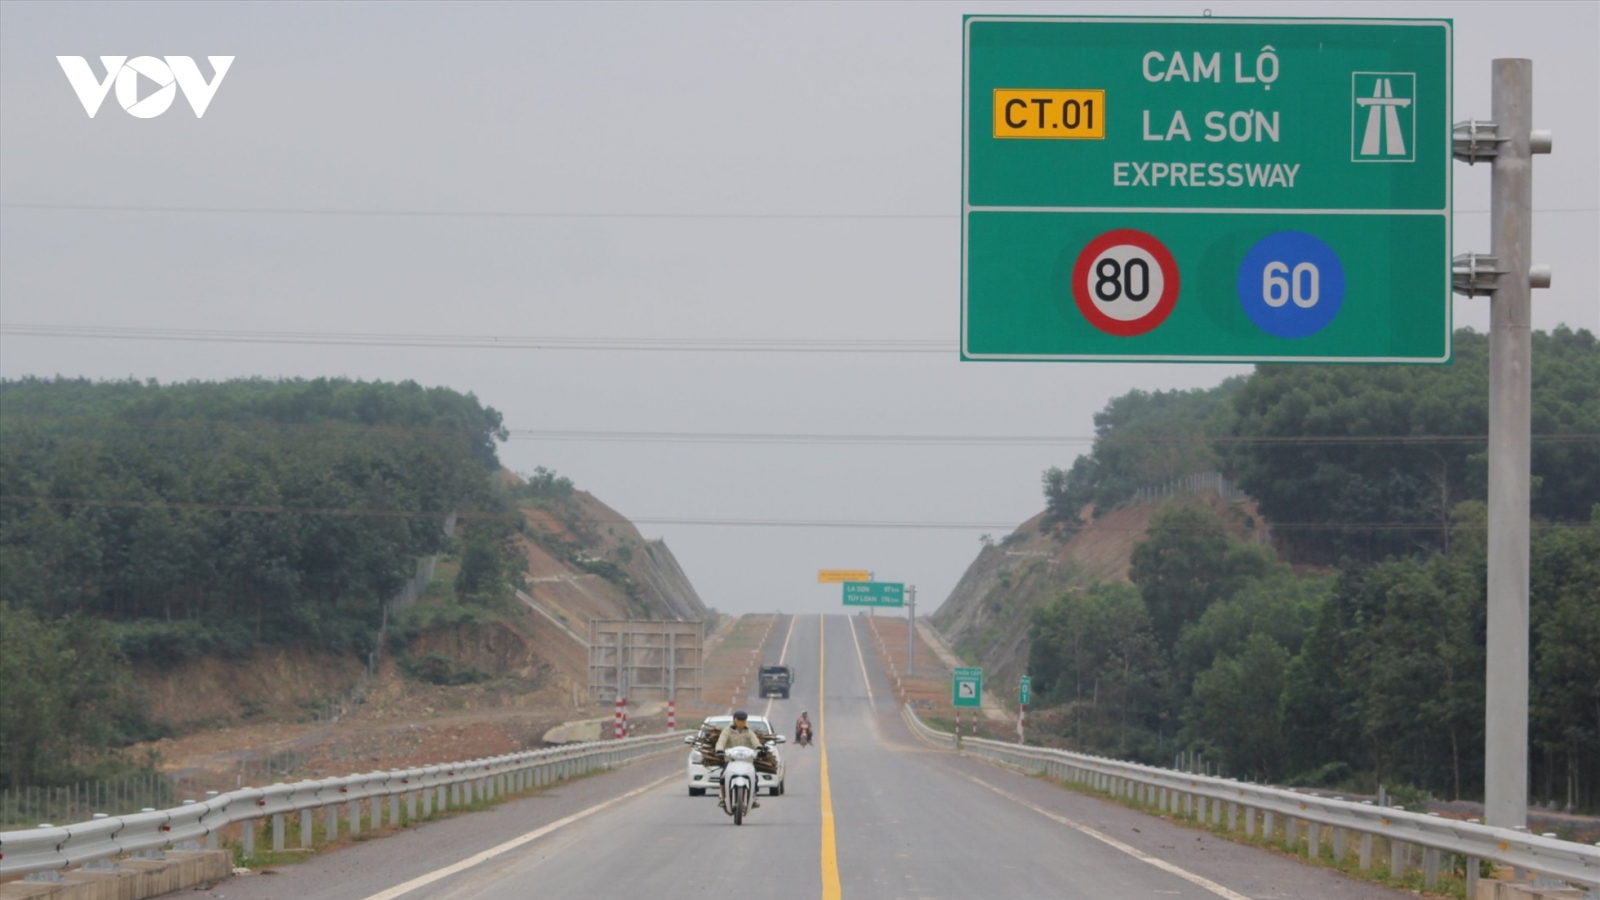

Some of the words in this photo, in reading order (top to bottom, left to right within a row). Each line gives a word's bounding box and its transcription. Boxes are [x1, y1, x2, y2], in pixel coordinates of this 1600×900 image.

[1142, 52, 1220, 82] CAM
[1236, 46, 1279, 90] LỘ
[1005, 98, 1093, 130] CT.01
[1143, 111, 1191, 141] LA
[1204, 109, 1279, 142] SƠN
[1113, 162, 1300, 187] EXPRESSWAY
[1095, 257, 1150, 302] 80
[1262, 261, 1319, 308] 60
